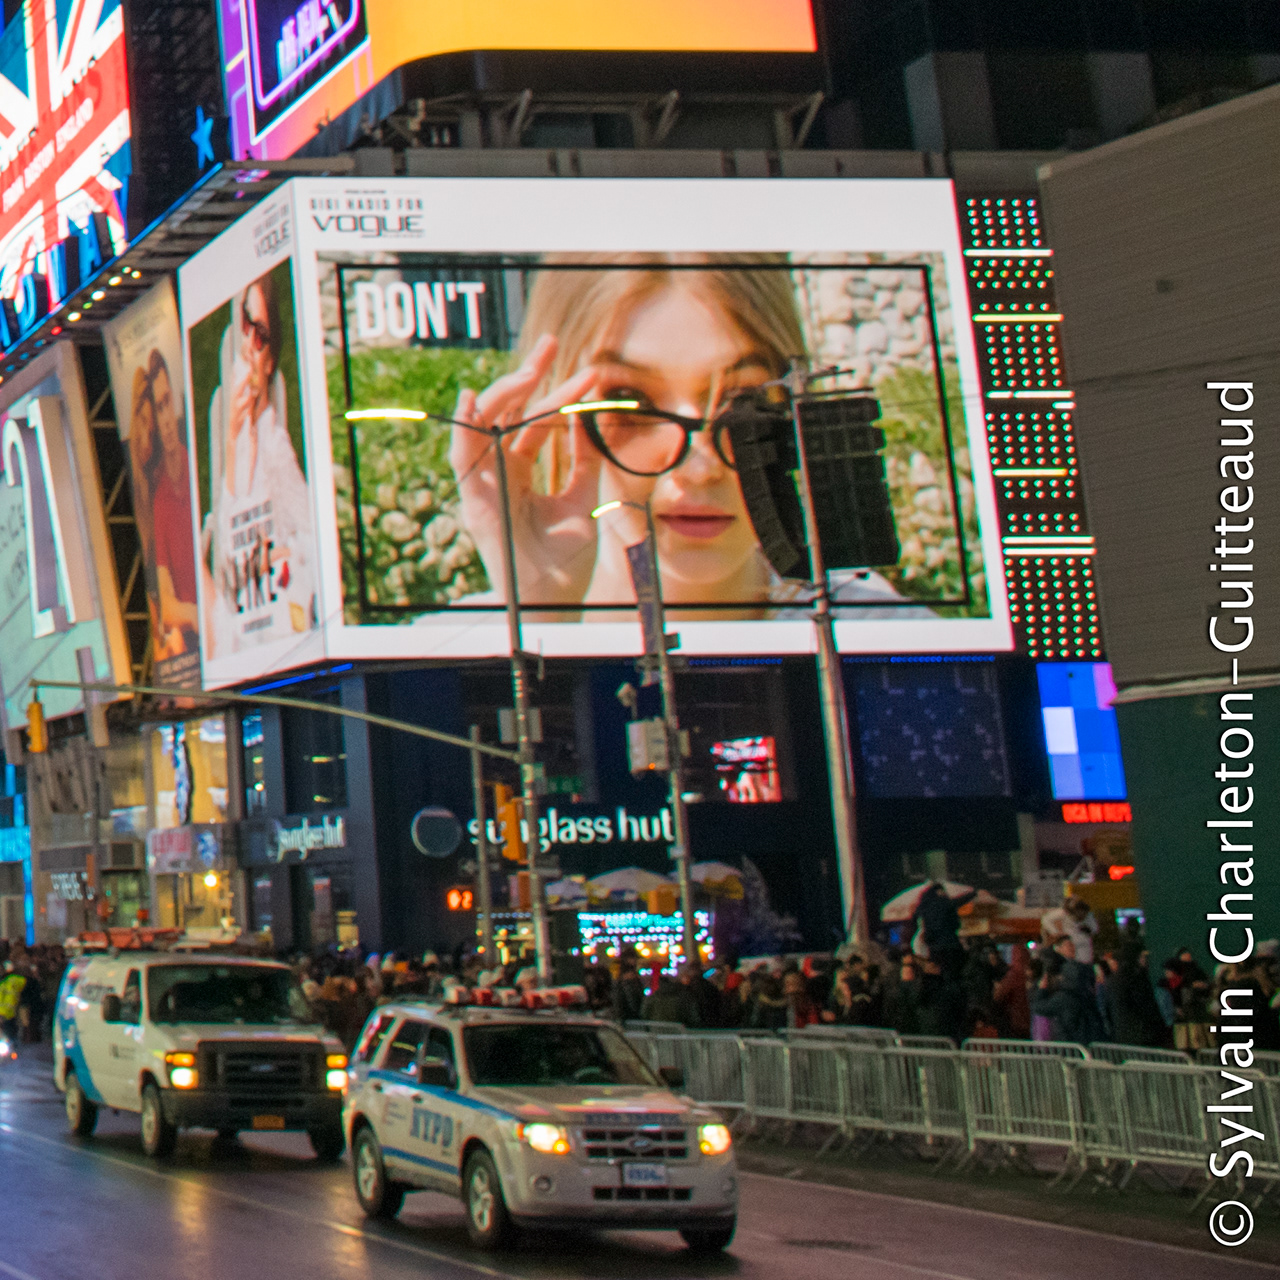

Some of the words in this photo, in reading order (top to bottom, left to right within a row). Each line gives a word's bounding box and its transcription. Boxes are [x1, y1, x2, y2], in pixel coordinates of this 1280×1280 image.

[309, 198, 339, 210] GIGI
[346, 198, 390, 210] HADID
[397, 198, 423, 210] FOR
[355, 281, 486, 339] DON'T
[616, 806, 676, 842] hut
